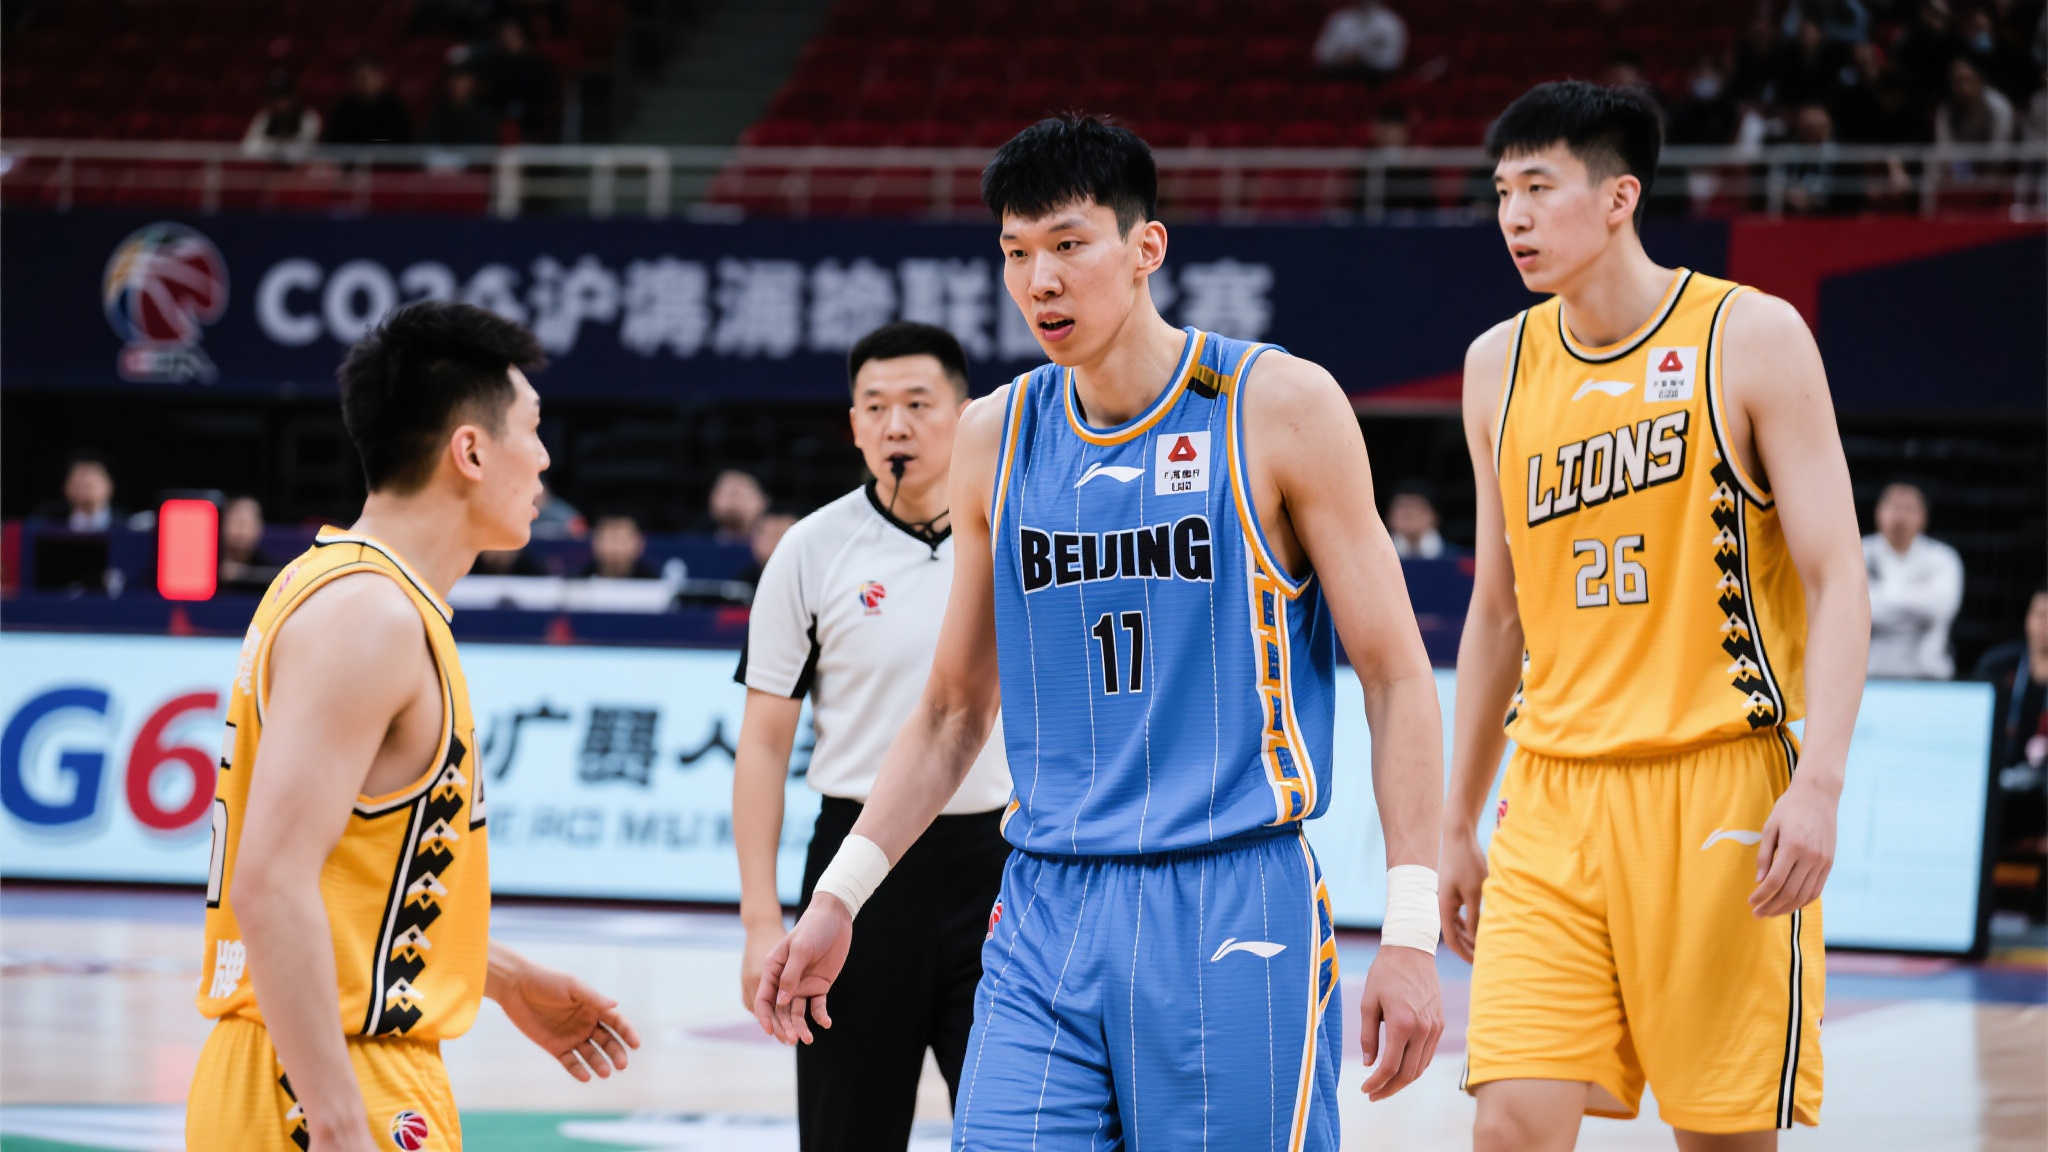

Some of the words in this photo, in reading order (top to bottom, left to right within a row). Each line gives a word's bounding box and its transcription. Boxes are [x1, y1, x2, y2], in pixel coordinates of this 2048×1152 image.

[1527, 409, 1690, 528] LIONS
[1019, 514, 1215, 595] BEIJING
[1573, 534, 1649, 608] 26
[1091, 610, 1145, 696] 17
